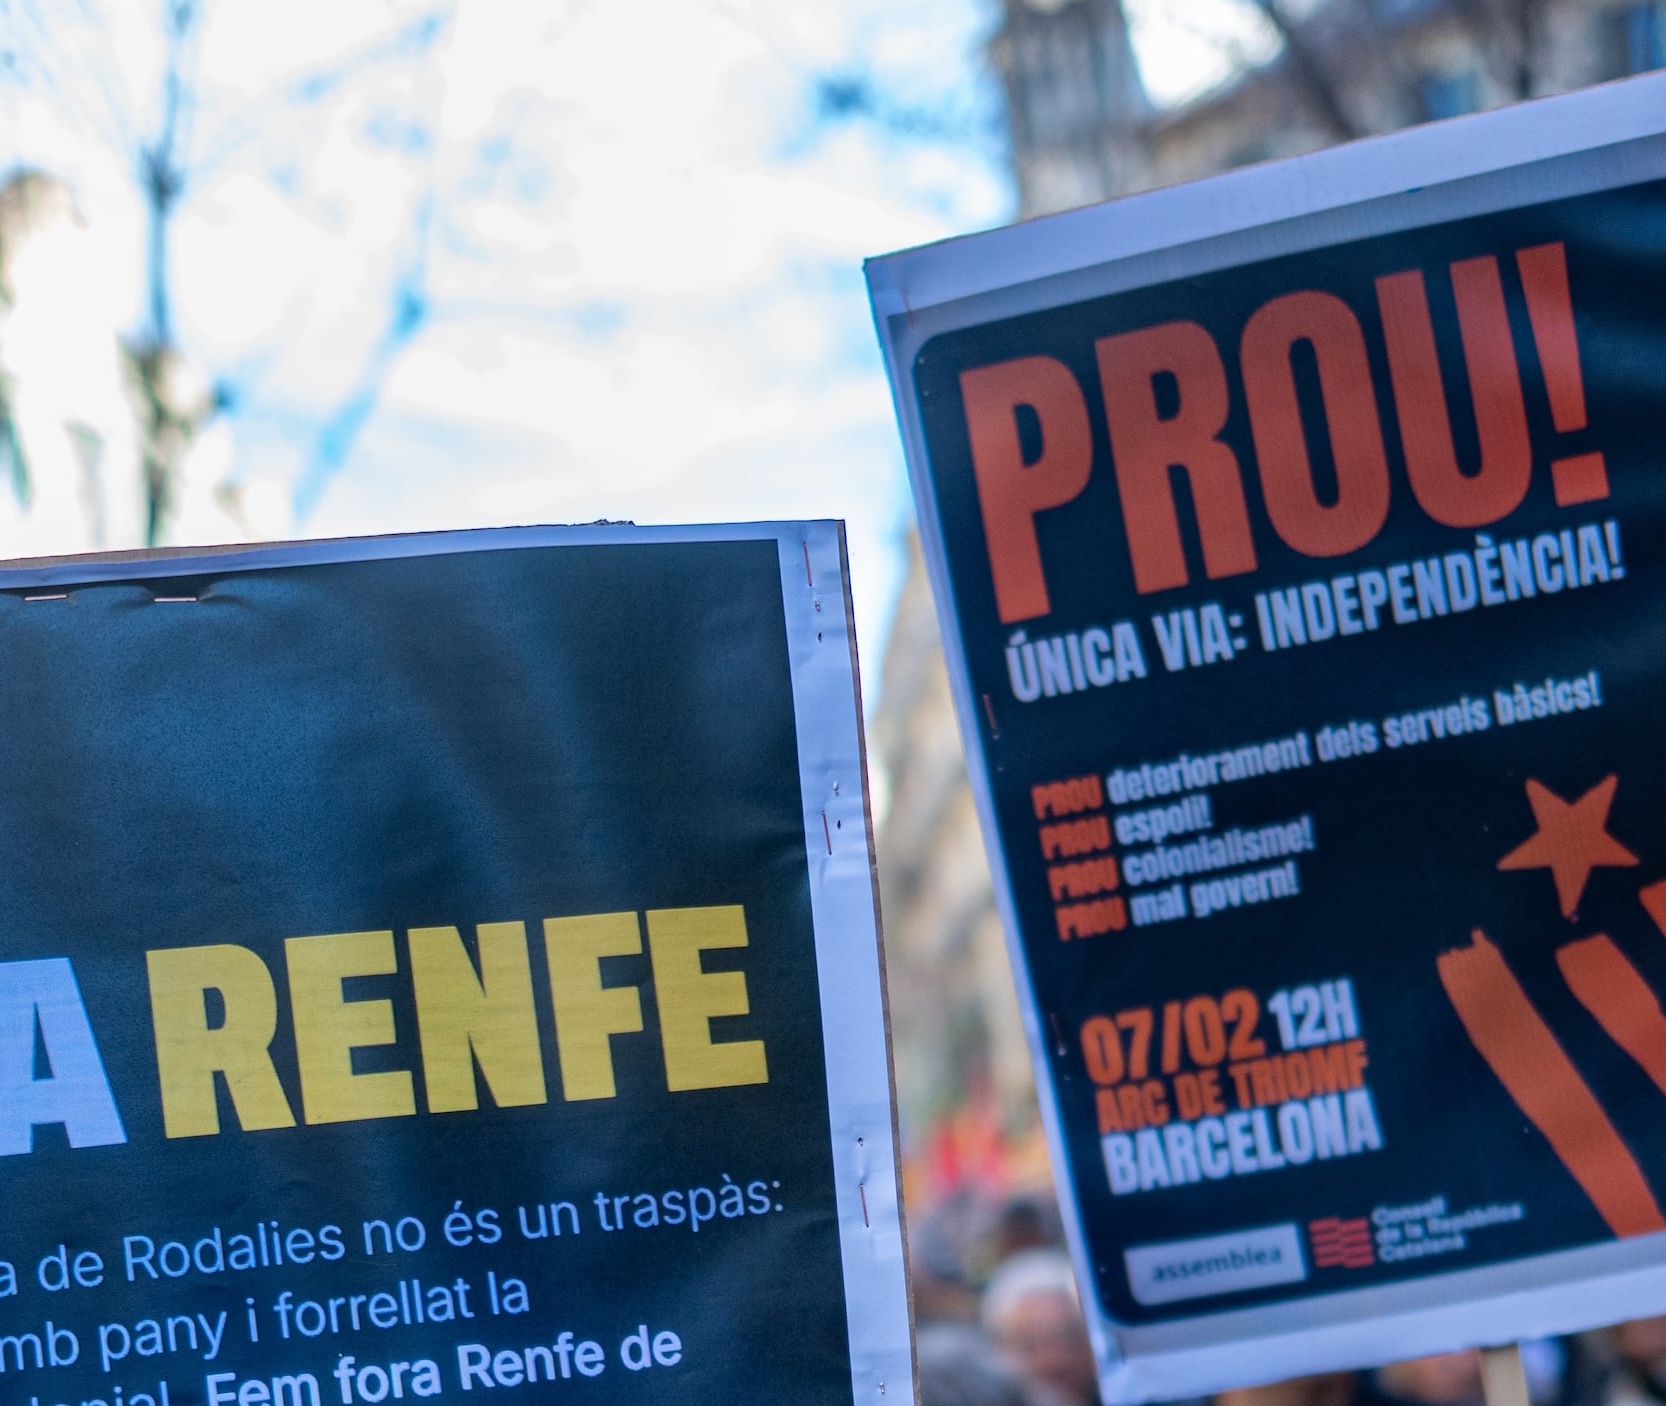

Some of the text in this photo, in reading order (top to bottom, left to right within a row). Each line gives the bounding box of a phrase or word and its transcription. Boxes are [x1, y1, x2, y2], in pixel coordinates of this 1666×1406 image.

[959, 241, 1610, 624] PROU!
[1005, 520, 1626, 703] ÚNICA VIA: INDEPENDÈNCIA!
[1032, 671, 1602, 820] PROU deteriorament dels serveis bàsics!
[1114, 794, 1212, 846] espoli!
[1123, 815, 1315, 887] colonialisme!
[1130, 882, 1186, 926] mal
[1192, 861, 1299, 920] govern!
[145, 905, 769, 1140] RENFE
[1080, 977, 1359, 1087] 07/02 12H
[1094, 1039, 1368, 1135] ARC DE TRIOMF
[1100, 1088, 1384, 1196] BARCELONA
[38, 1245, 104, 1291] de
[123, 1222, 345, 1282] Rodalies
[363, 1214, 426, 1256] no
[443, 1200, 501, 1247] és
[519, 1200, 579, 1240] un
[594, 1174, 783, 1232] traspàs:
[1372, 1196, 1446, 1228] Consell
[1152, 1245, 1283, 1283] assemblea
[99, 1310, 226, 1370] pany
[246, 1298, 260, 1344] i
[273, 1277, 474, 1341] forrellat
[487, 1271, 529, 1316] la
[334, 1355, 442, 1406] fora
[456, 1331, 605, 1391] Renfe
[619, 1324, 682, 1372] de
